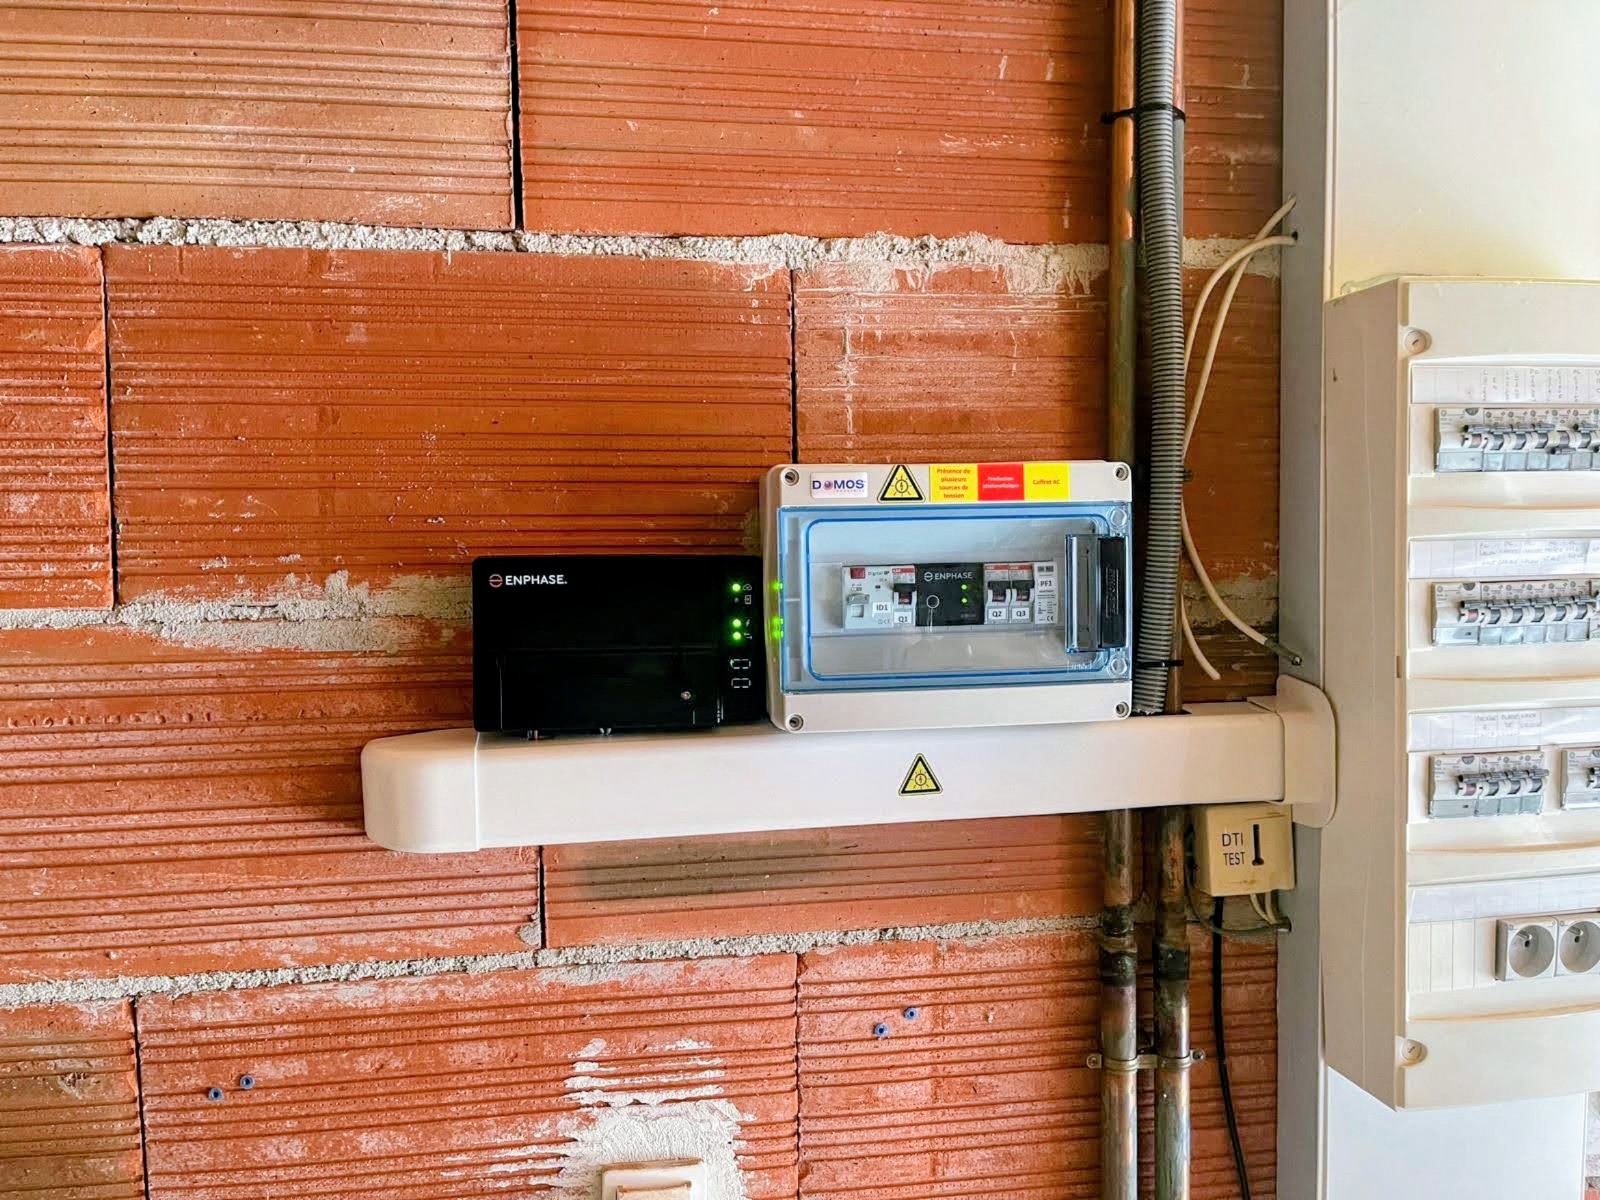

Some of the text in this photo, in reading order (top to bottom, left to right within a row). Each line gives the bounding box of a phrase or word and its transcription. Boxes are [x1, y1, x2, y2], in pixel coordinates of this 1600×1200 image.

[934, 571, 973, 580] ENPHASE
[992, 610, 1002, 618] Q2
[898, 615, 908, 623] Q1
[1221, 832, 1244, 847] DTI
[1223, 851, 1246, 866] TEST
